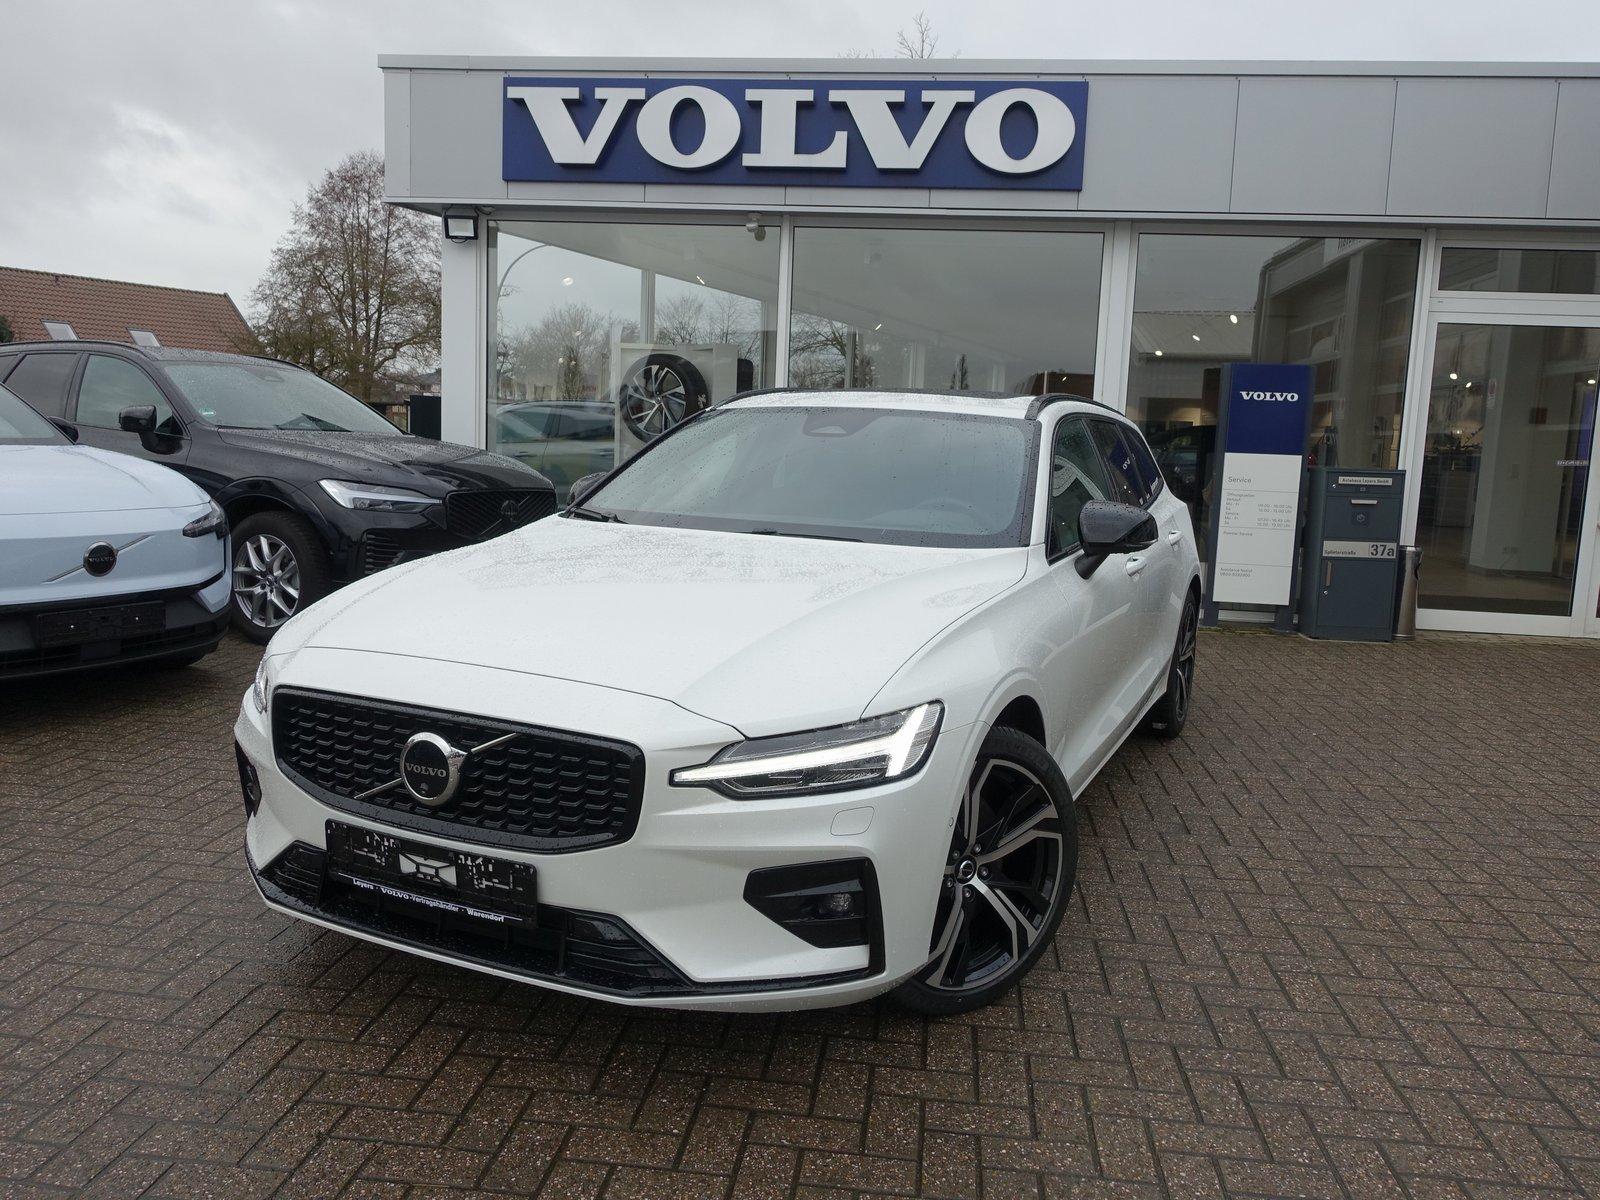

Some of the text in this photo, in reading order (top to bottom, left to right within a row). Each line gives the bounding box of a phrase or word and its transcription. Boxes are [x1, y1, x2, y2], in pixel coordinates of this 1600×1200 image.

[506, 85, 1076, 174] VOLVO
[1239, 390, 1299, 402] VOLVO
[1370, 544, 1395, 557] 37a
[404, 762, 447, 778] VOLVO
[352, 878, 374, 890] Leyers
[466, 907, 504, 923] Warendorf
